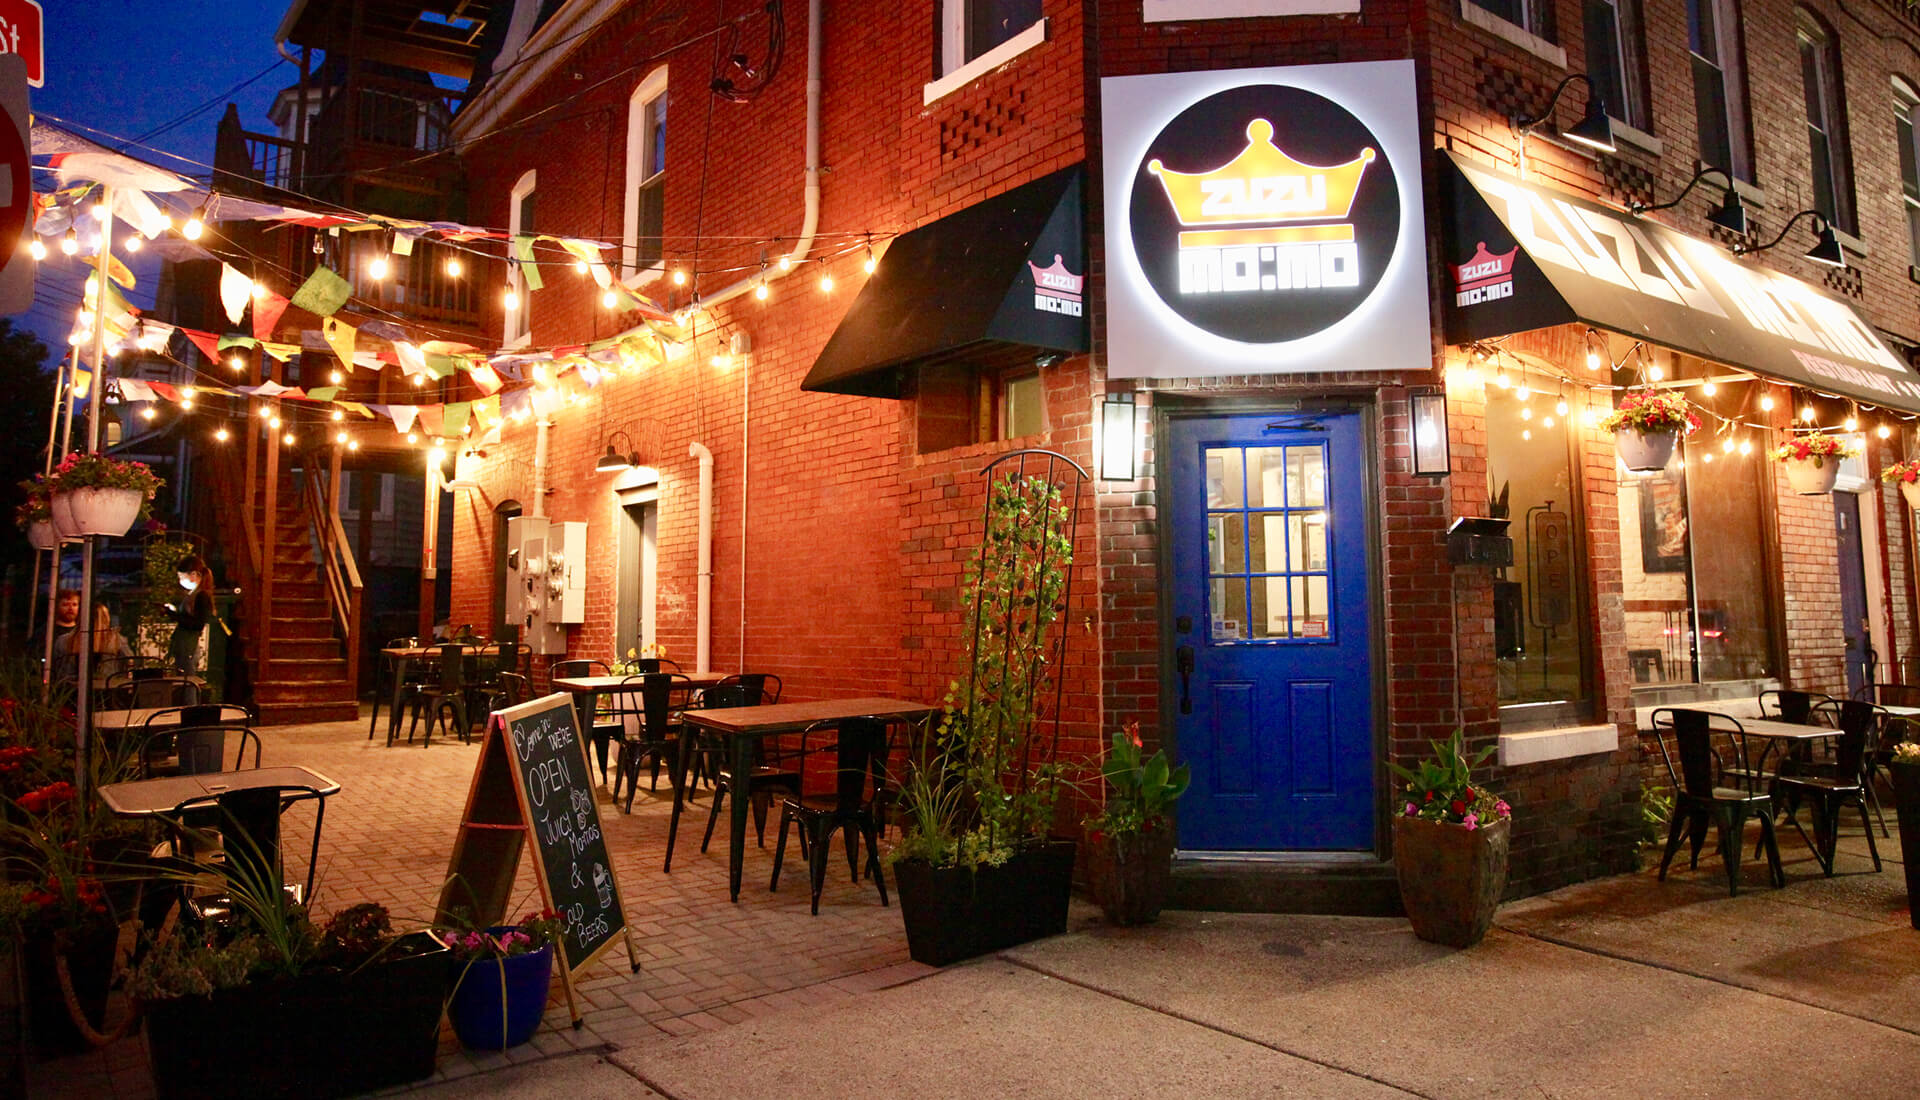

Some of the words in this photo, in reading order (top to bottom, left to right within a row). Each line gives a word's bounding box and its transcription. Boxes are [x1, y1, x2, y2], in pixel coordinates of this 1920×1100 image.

[1200, 174, 1327, 216] ZUZU
[1462, 162, 1730, 320] ZUZU
[1041, 272, 1076, 290] ZUZU
[1461, 258, 1502, 281] ZUZU
[529, 756, 571, 807] OPEN
[571, 861, 585, 889] &
[576, 913, 609, 949] BEERS
